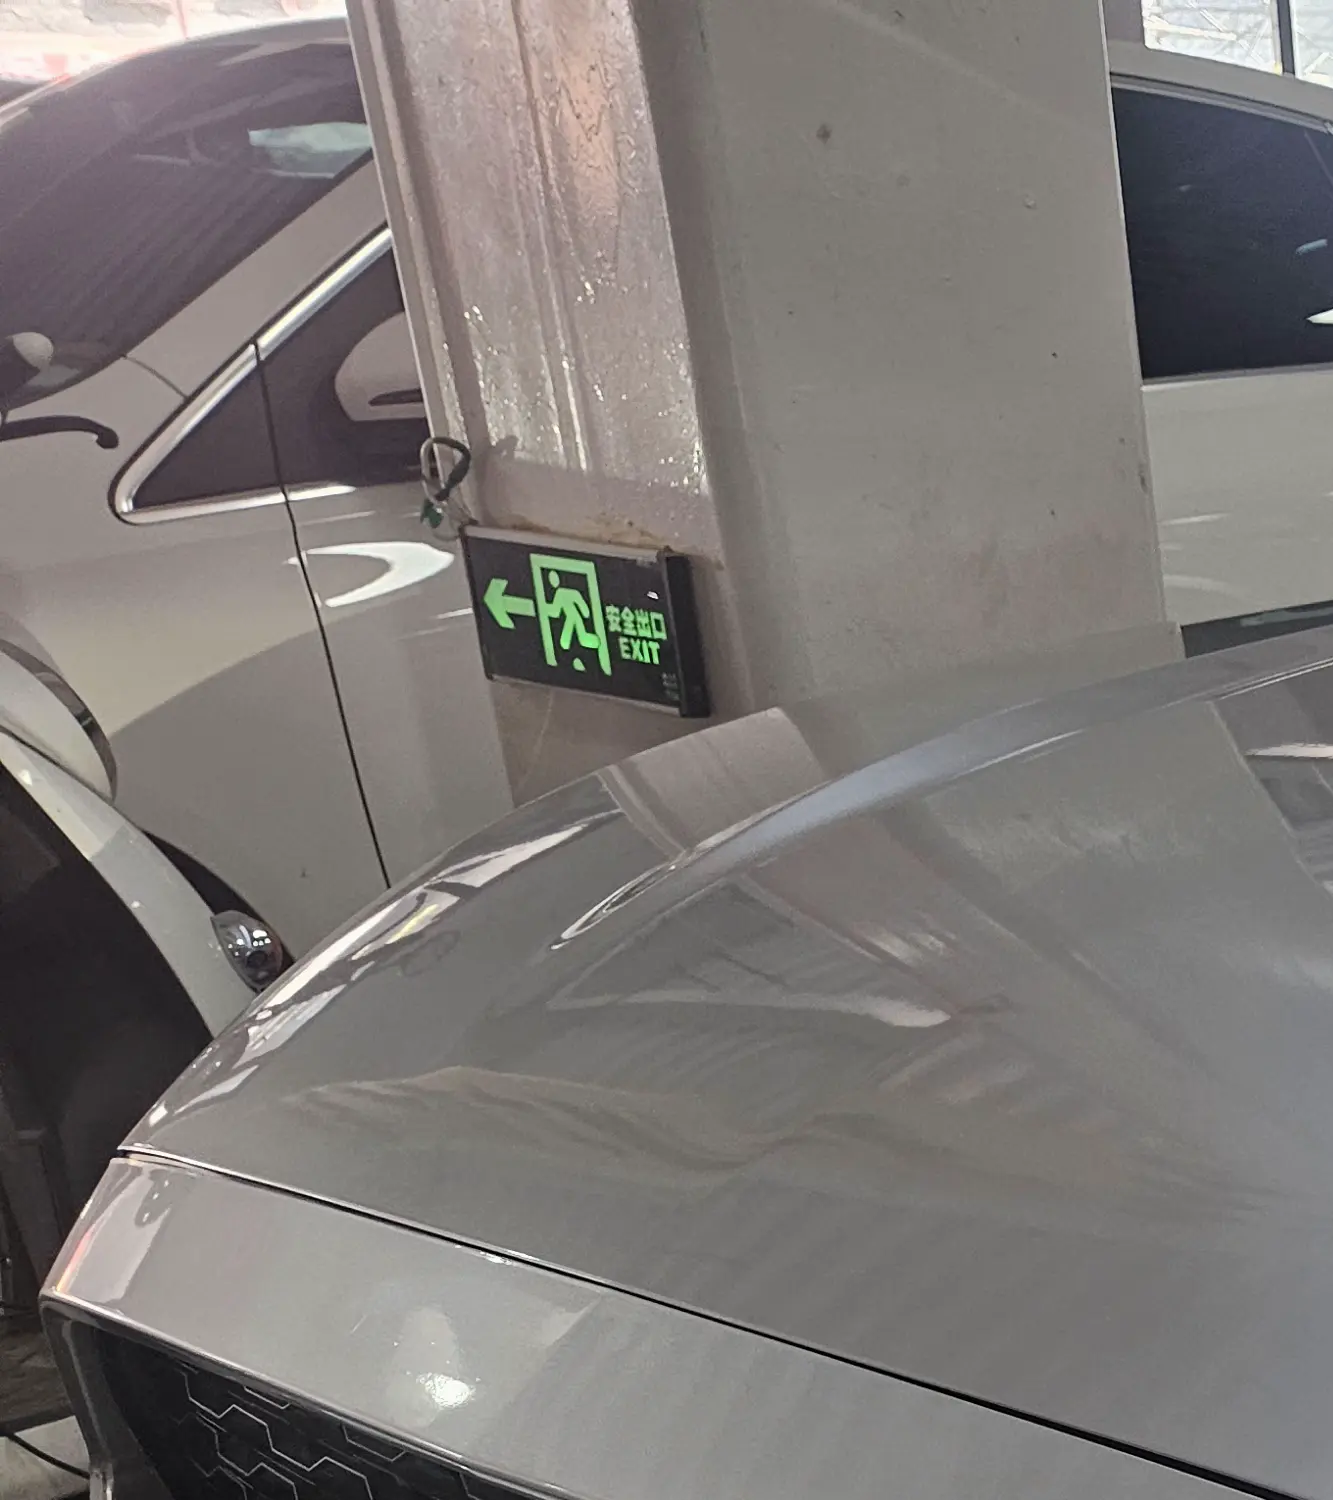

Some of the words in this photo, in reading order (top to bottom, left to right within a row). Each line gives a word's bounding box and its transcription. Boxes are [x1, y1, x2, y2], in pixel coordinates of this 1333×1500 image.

[605, 604, 668, 640] 安全出口
[618, 636, 660, 664] EXIT
